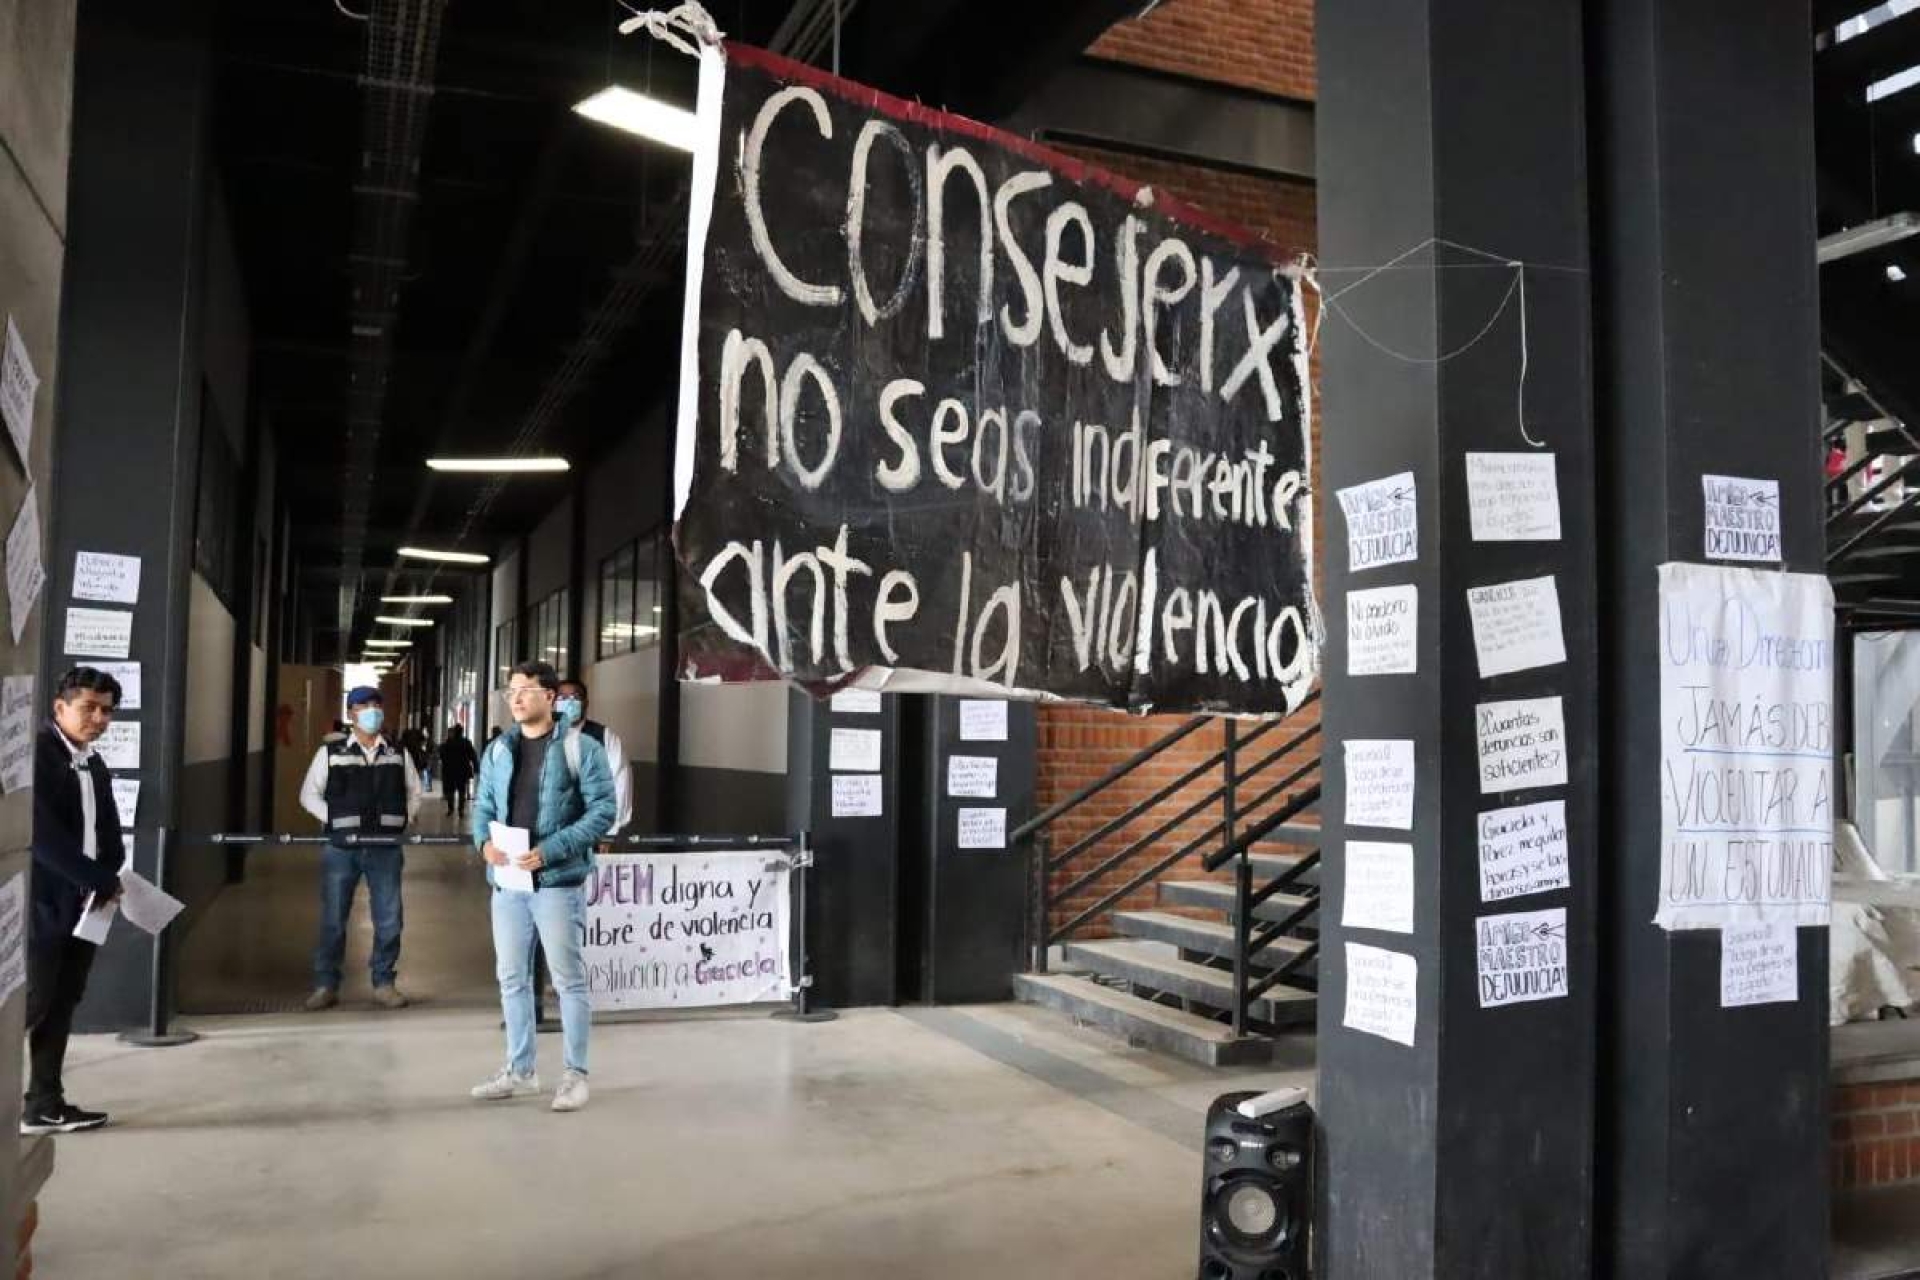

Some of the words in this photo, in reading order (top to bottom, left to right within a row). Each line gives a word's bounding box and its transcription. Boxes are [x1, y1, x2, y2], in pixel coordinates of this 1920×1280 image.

[720, 328, 842, 490] no
[875, 378, 1042, 506] seas
[700, 523, 919, 671] ante
[953, 550, 1023, 688] la
[1061, 547, 1312, 686] violencia
[1667, 757, 1798, 826] VIOLENTAR
[660, 863, 734, 911] digna
[747, 879, 762, 910] y
[649, 911, 675, 941] de
[681, 910, 773, 938] violencia
